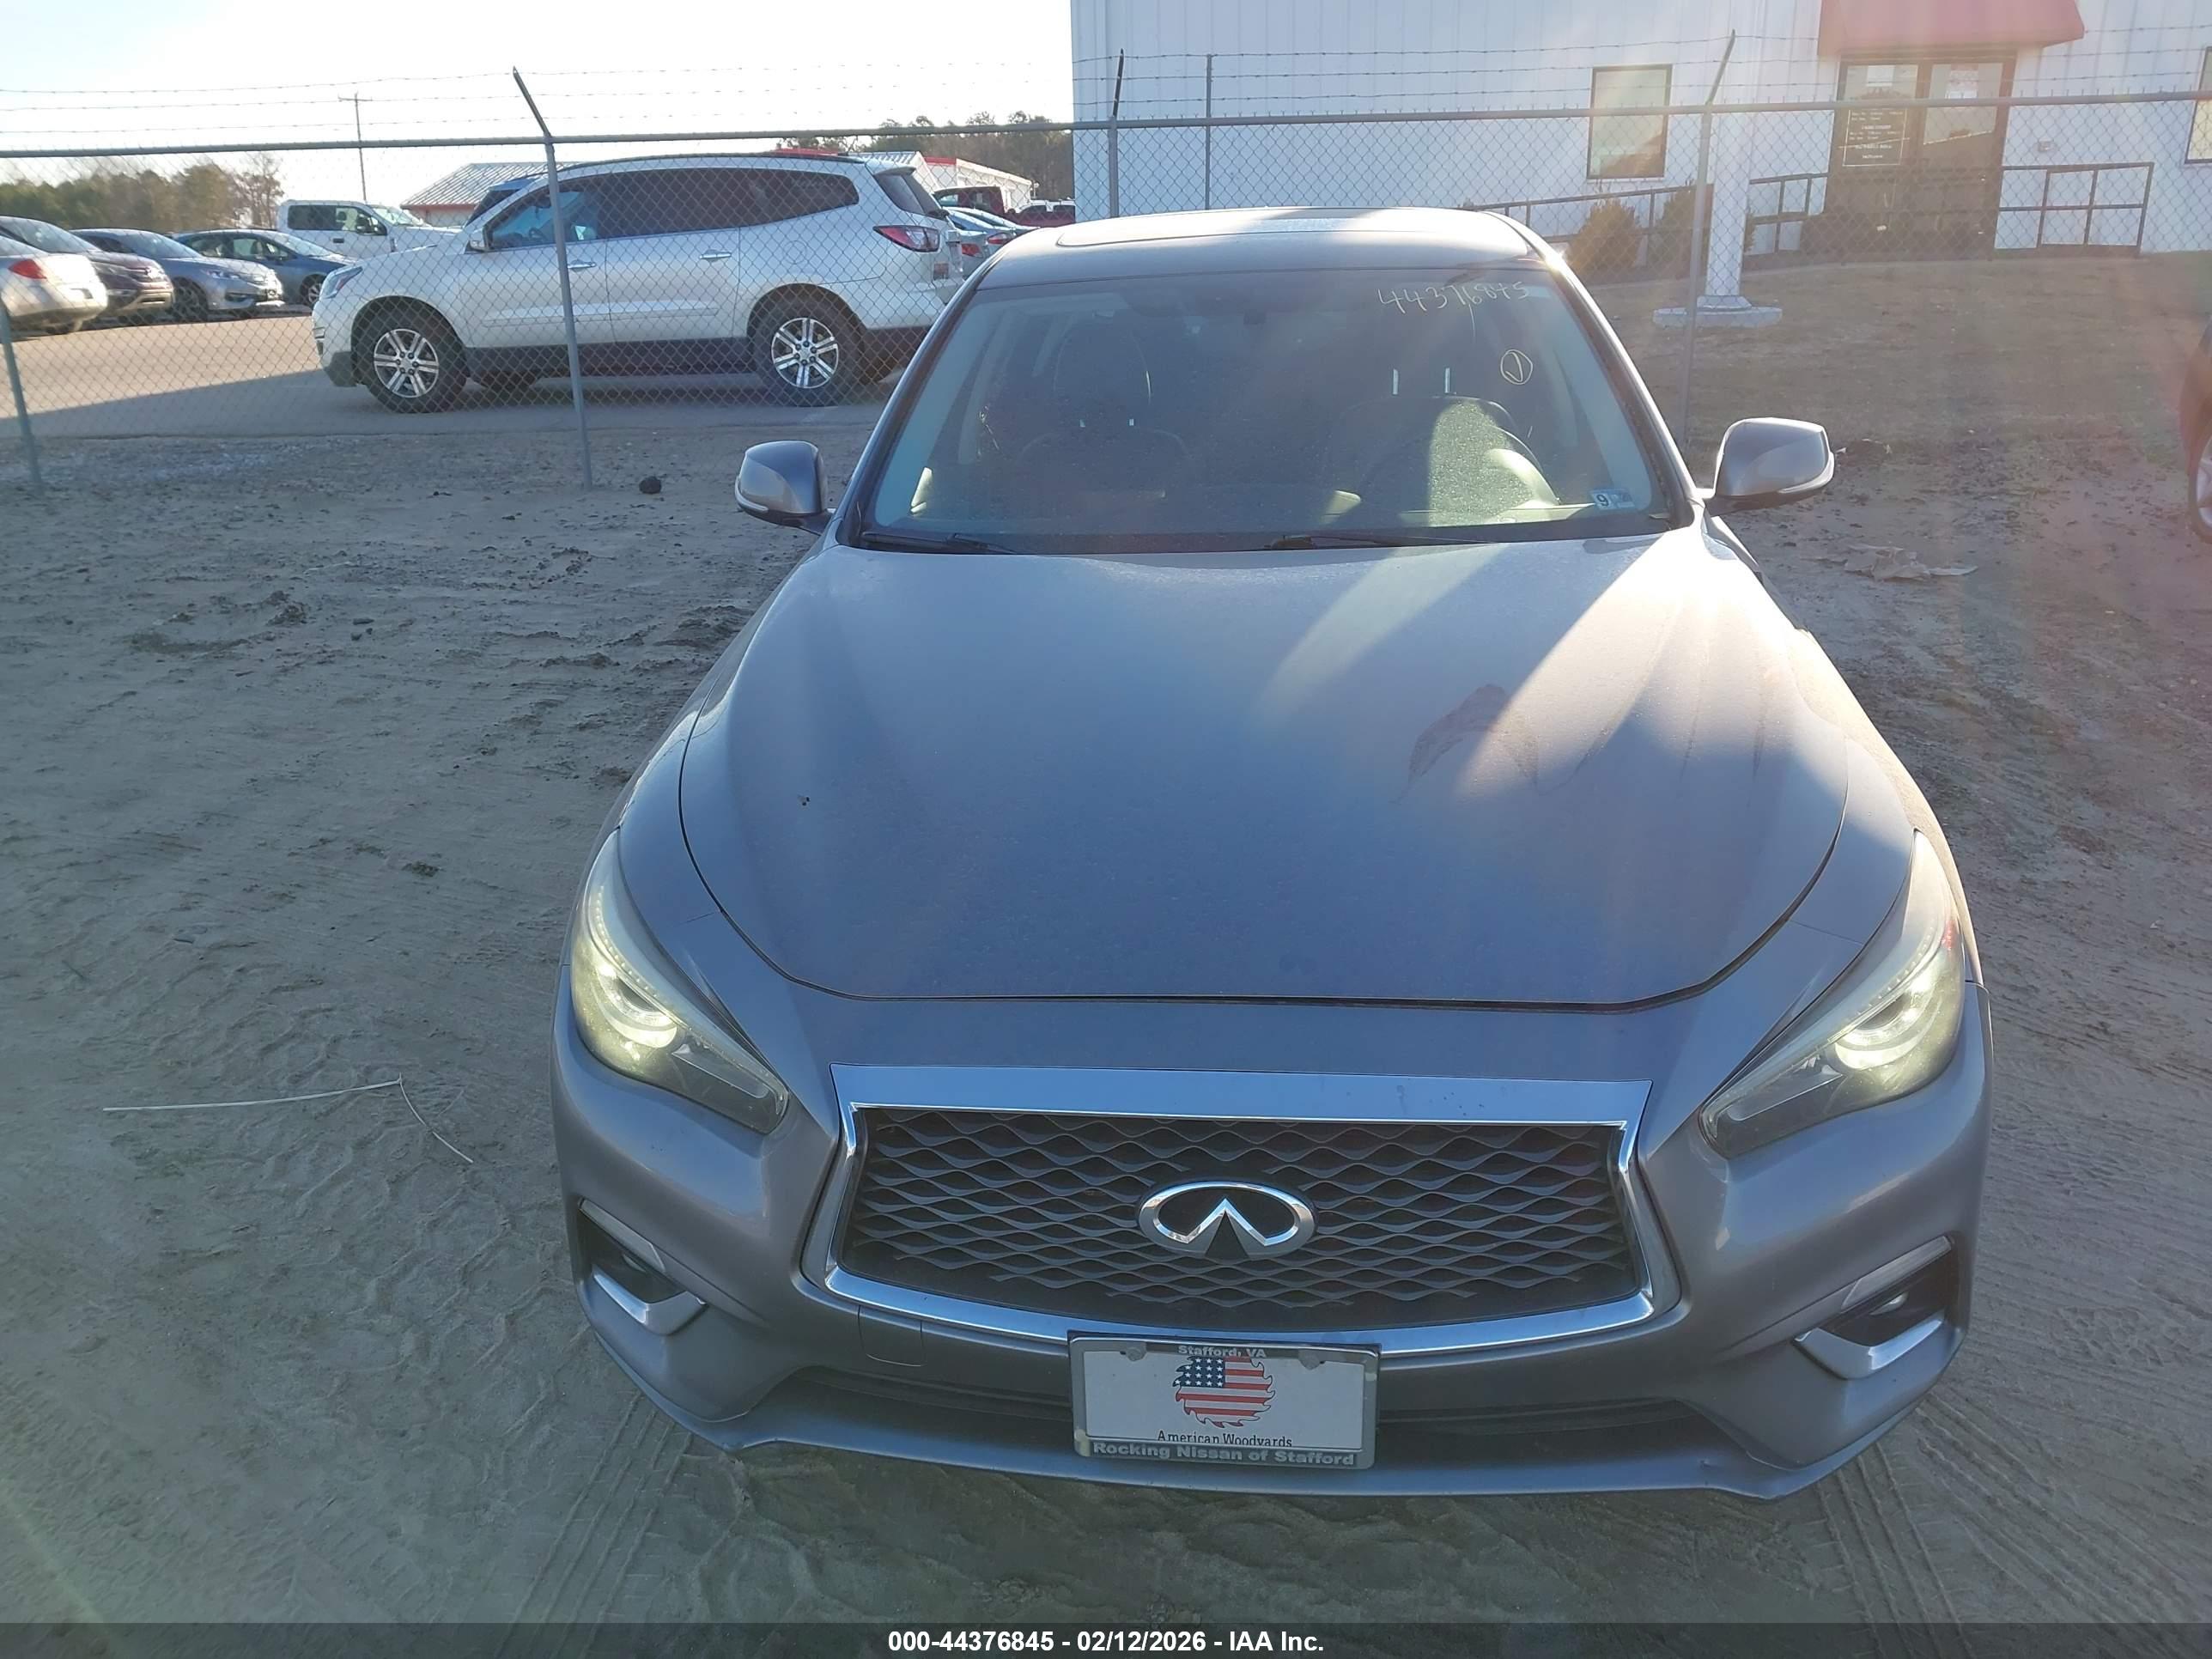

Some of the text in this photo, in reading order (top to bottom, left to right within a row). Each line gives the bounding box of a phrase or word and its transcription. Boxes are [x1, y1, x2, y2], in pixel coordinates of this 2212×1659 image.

[1377, 281, 1529, 314] 44376845
[1596, 494, 1609, 507] 9
[1177, 1345, 1267, 1358] Stafford, VA
[1157, 1430, 1219, 1444] American
[1092, 1442, 1355, 1466] Rocking Nissan of Stafford
